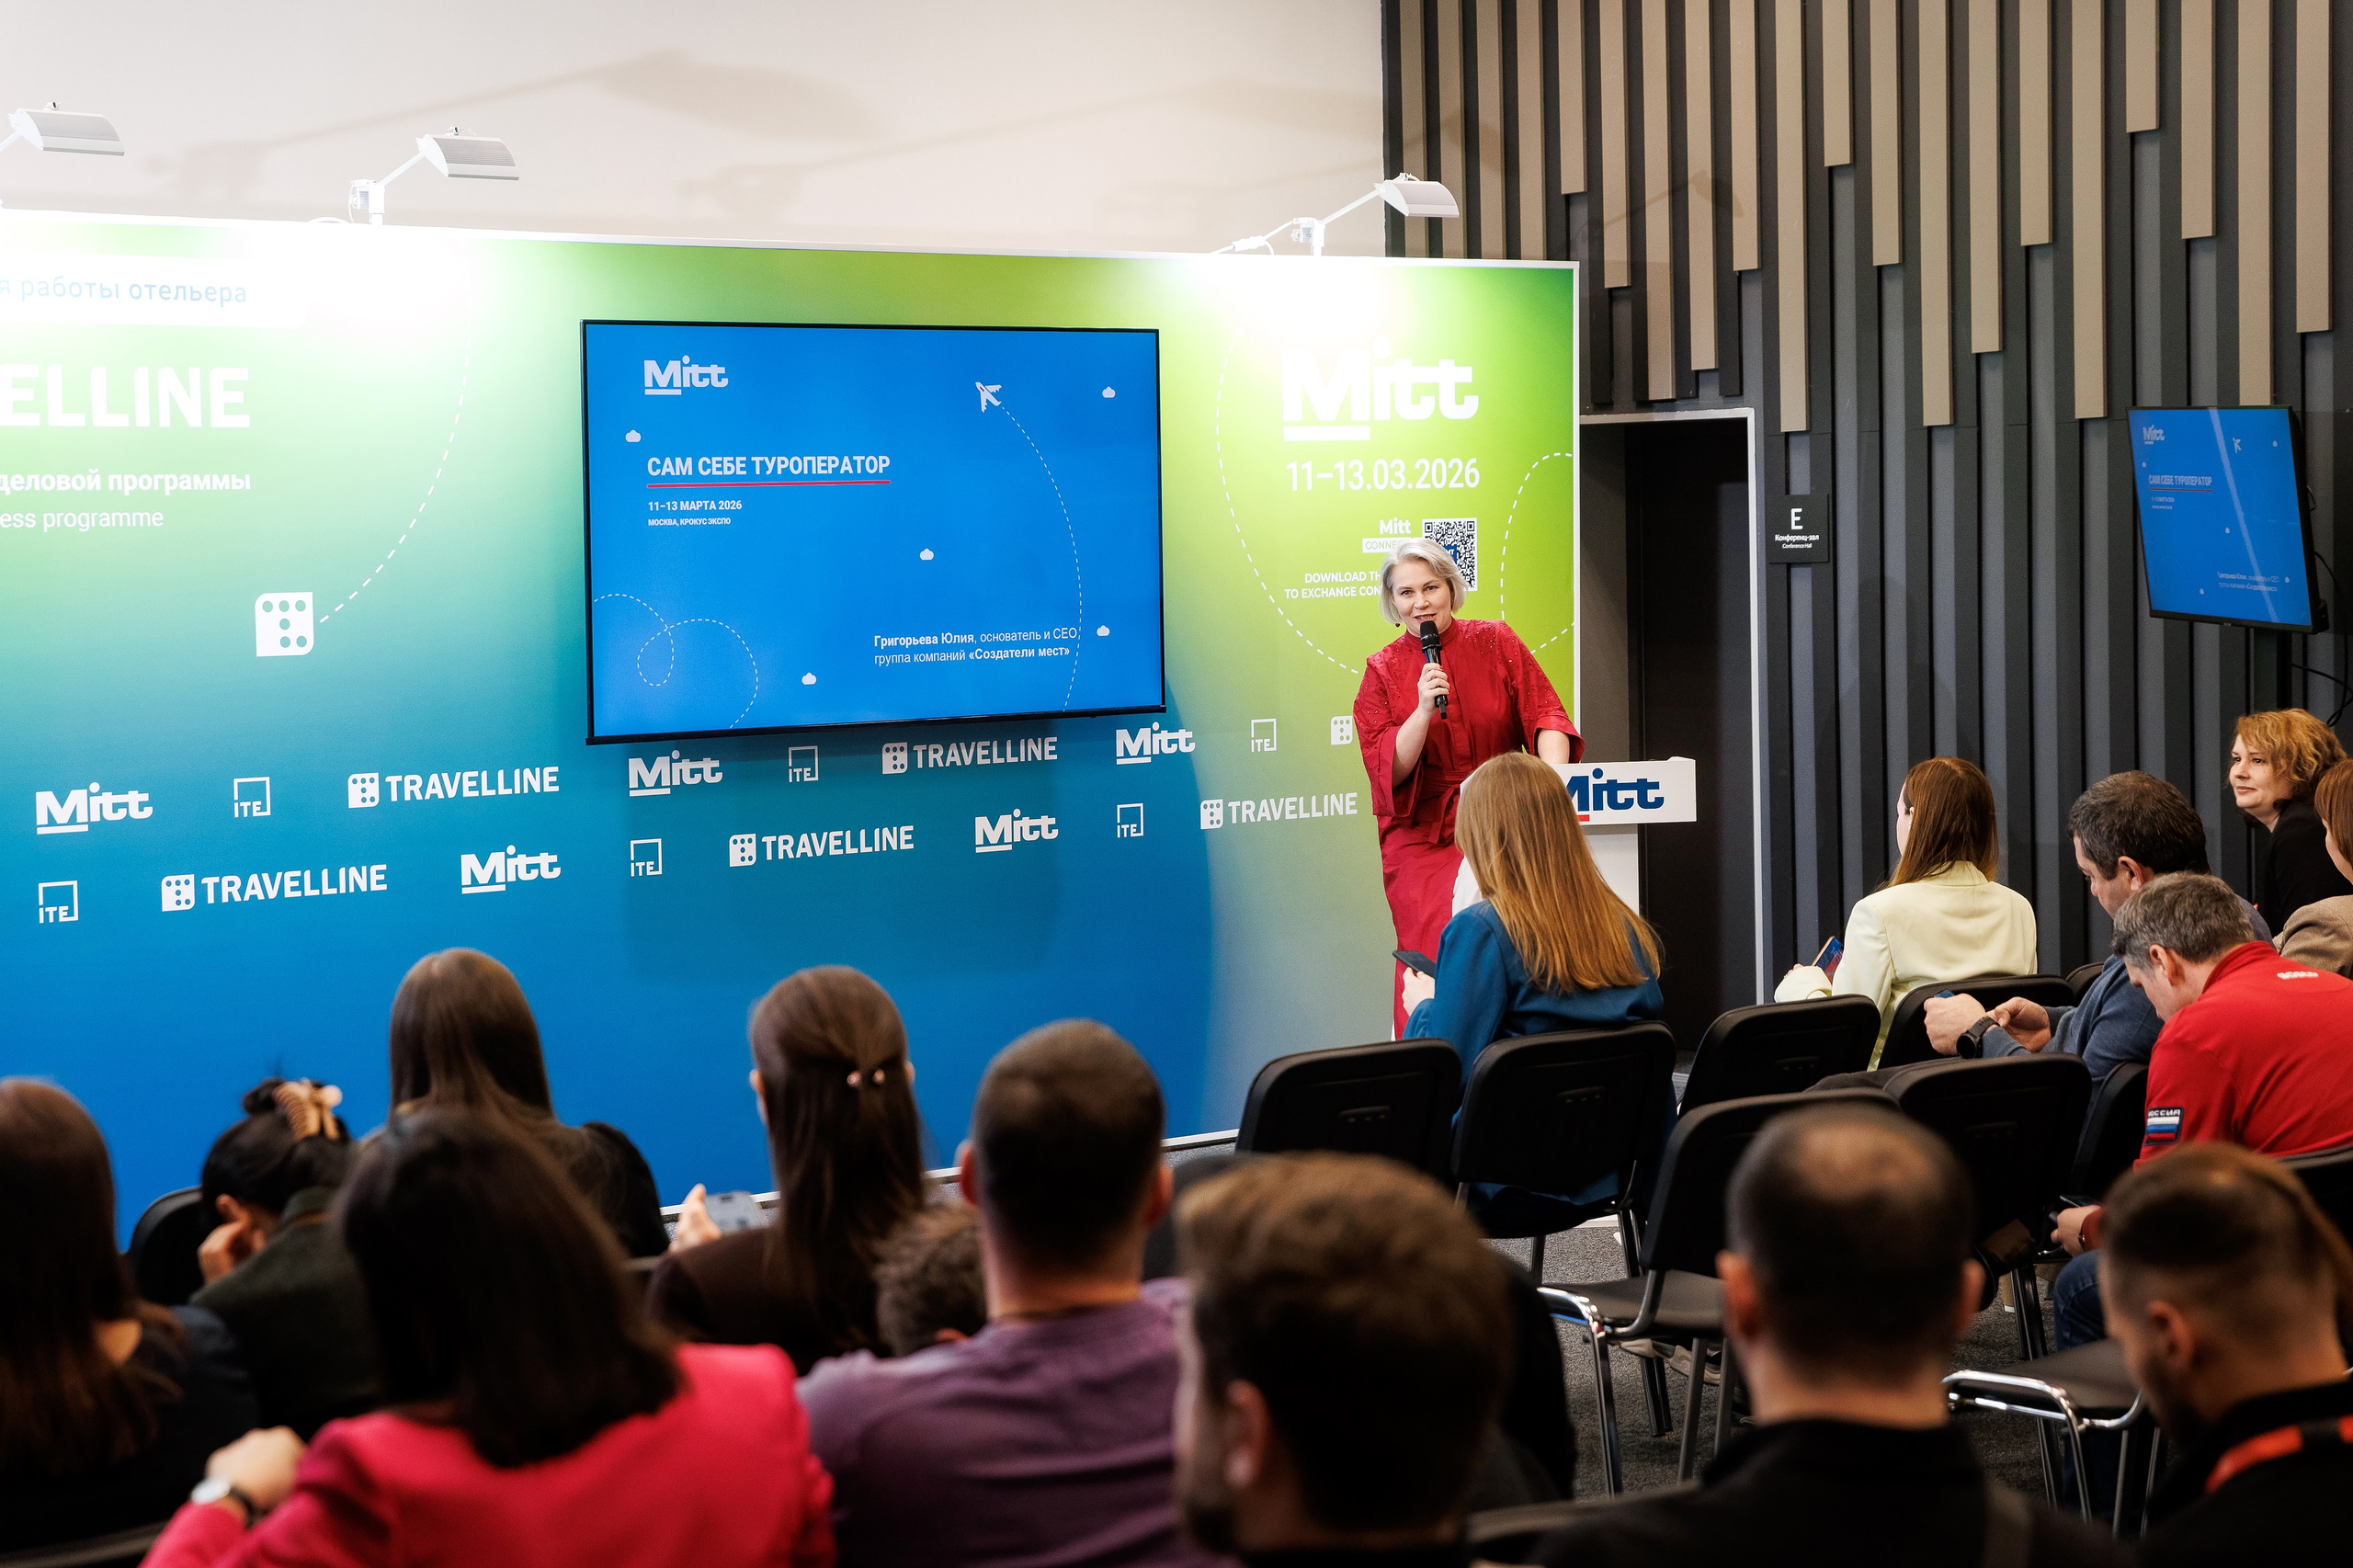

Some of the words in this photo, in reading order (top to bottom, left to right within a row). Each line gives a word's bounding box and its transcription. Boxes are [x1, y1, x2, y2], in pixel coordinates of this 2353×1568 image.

[21, 275, 119, 301] работы
[130, 283, 246, 308] отельера
[644, 356, 728, 388] Mitt
[1282, 335, 1479, 422] Mitt
[647, 457, 693, 476] САМ
[698, 456, 747, 476] СЕБЕ
[751, 455, 891, 475] ТУРОПЕРАТОР
[0, 468, 101, 495] деловой
[108, 472, 251, 496] программы
[679, 500, 717, 511] МАРТА
[718, 499, 743, 511] 2026
[1790, 507, 1803, 530] E
[43, 511, 164, 533] programme
[647, 517, 679, 527] МОСКВА,
[679, 517, 708, 526] КРОКУС
[708, 517, 732, 525] ЭКСПО
[1380, 517, 1411, 535] Mitt
[1365, 540, 1403, 551] CONNE
[1284, 588, 1299, 599] TO
[1302, 586, 1358, 598] EXCHANGE
[1358, 585, 1383, 597] CON
[1304, 571, 1367, 584] DOWNLOAD
[874, 635, 938, 650] Григорьева
[941, 631, 978, 645] Юлия,
[980, 631, 1041, 642] основатель
[1043, 631, 1051, 641] и
[874, 653, 911, 667] группа
[914, 649, 966, 663] компаний
[968, 648, 1035, 661] «Создатели
[1038, 646, 1071, 657] мест»
[913, 736, 1058, 769] TRAVELLINE
[1116, 722, 1196, 758] Mitt
[384, 766, 560, 802] TRAVELLINE
[629, 750, 722, 788] Mitt
[36, 781, 153, 824] Mitt
[1227, 791, 1358, 824] TRAVELLINE
[761, 824, 915, 861] TRAVELLINE
[975, 809, 1059, 846] Mitt
[460, 845, 562, 886] Mitt
[200, 863, 388, 904] TRAVELLINE
